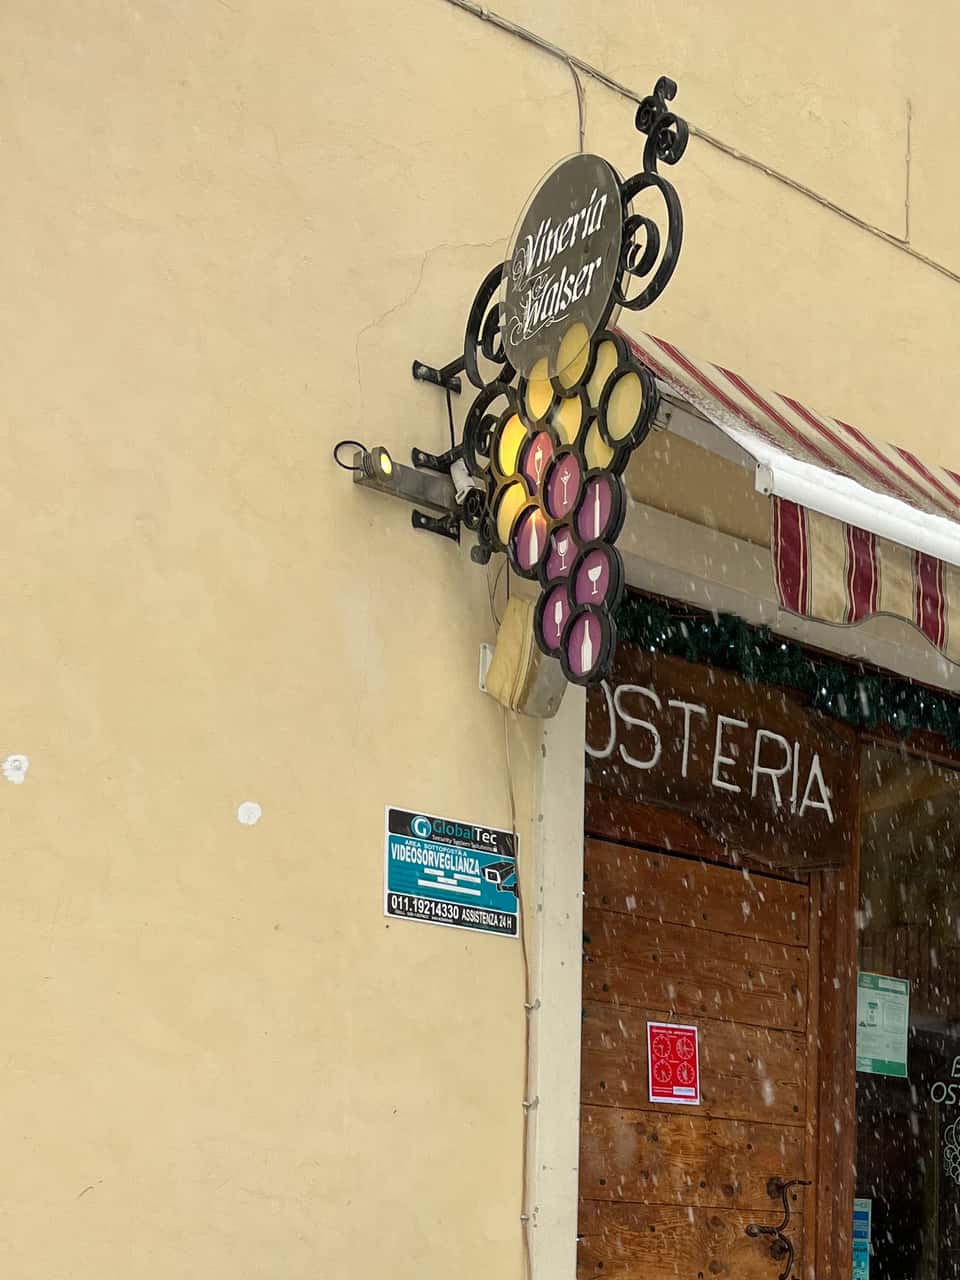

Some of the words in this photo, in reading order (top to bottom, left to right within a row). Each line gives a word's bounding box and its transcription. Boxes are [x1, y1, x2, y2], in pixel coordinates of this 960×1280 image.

[432, 819, 497, 845] GlobalTec
[391, 842, 480, 875] VIDEOSORVEGLIANZA
[391, 894, 459, 919] 011.19214330
[461, 908, 498, 926] ASSISTENZA
